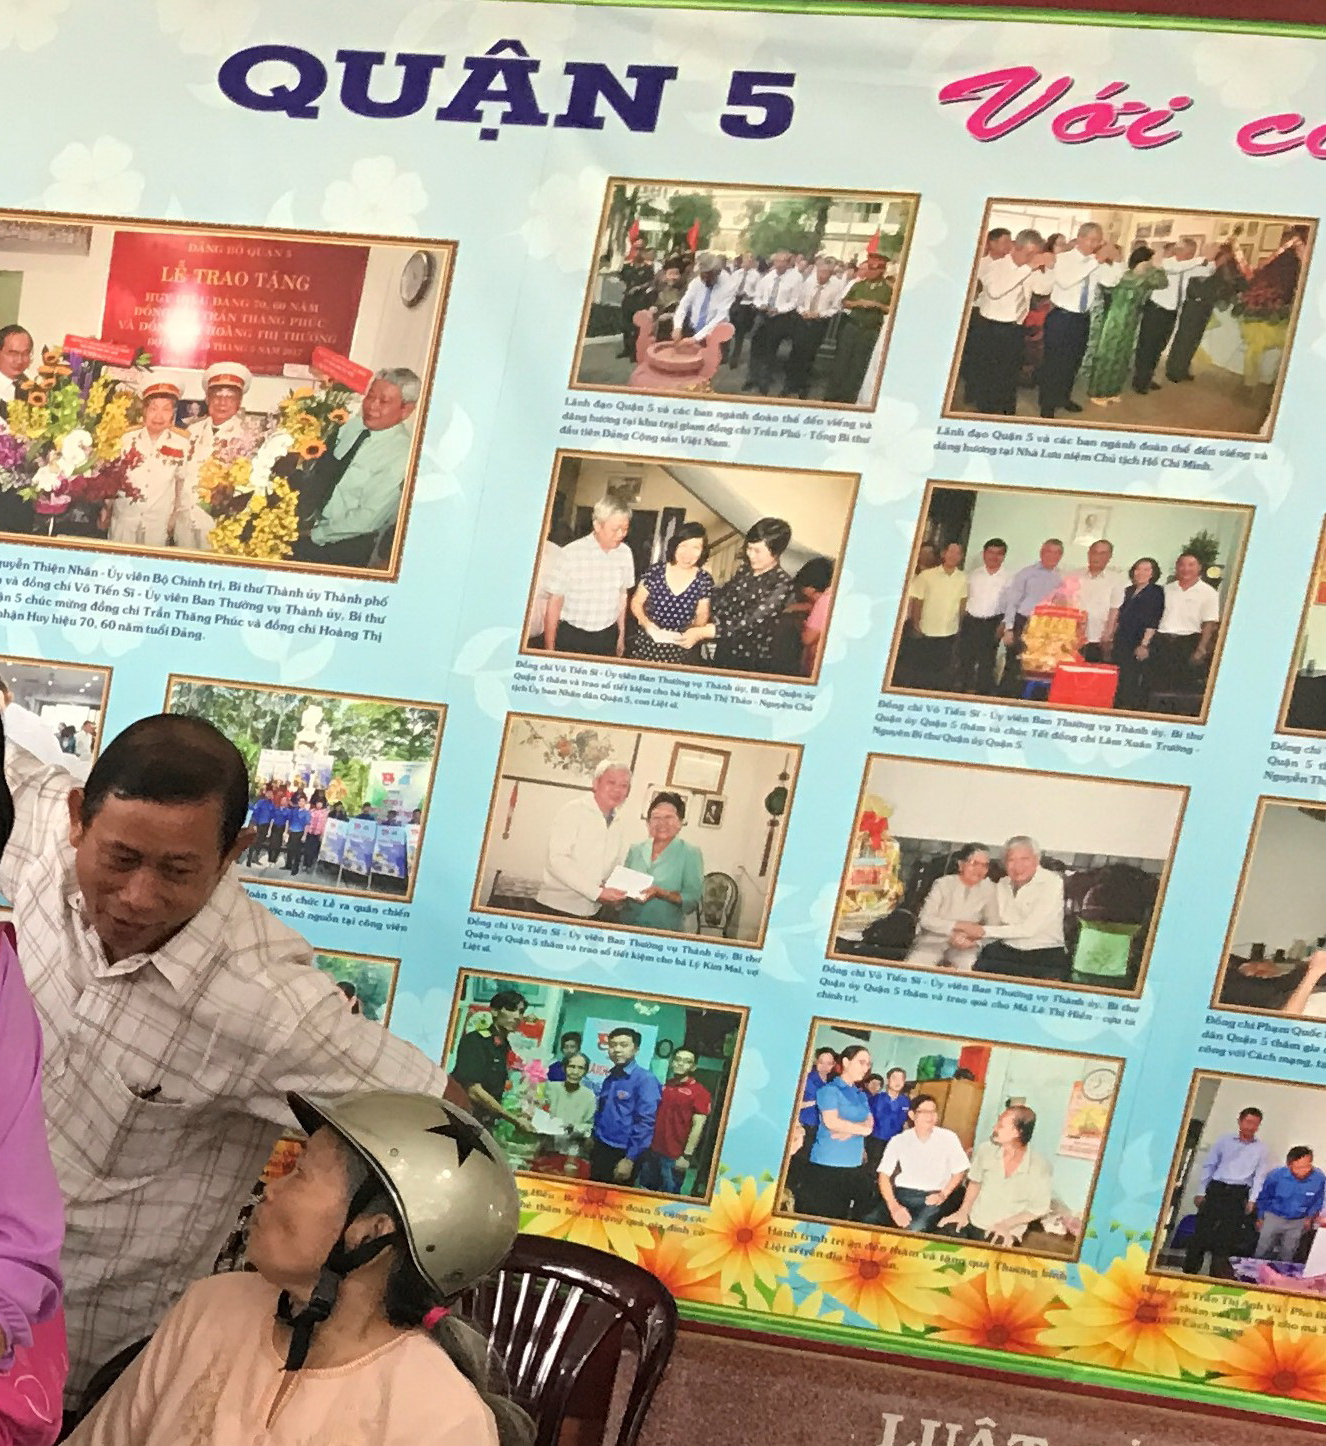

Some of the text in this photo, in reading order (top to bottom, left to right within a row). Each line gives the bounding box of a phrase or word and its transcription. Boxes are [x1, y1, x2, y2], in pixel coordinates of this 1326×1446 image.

[217, 38, 797, 141] QUẬN 5
[938, 66, 1194, 150] Với
[161, 259, 310, 292] LỄ TRAO TẶNG
[6, 576, 18, 586] và
[22, 577, 50, 591] đồng
[54, 581, 71, 592] chí
[75, 583, 90, 593] Võ
[94, 584, 119, 596] Tiến
[123, 587, 135, 597] Sĩ
[164, 592, 189, 603] viên
[192, 595, 215, 606] Ban
[219, 597, 263, 613] Thường
[267, 604, 281, 615] vụ
[286, 604, 323, 618] Thành
[349, 611, 361, 622] Bí
[365, 613, 385, 625] thư
[33, 561, 65, 574] Thiện
[68, 565, 98, 577] Nhân
[126, 570, 150, 582] viên
[153, 574, 168, 586] Bộ
[172, 575, 205, 588] Chính
[229, 581, 240, 591] Bí
[244, 584, 265, 593] thư
[265, 585, 303, 598] Thành
[306, 588, 321, 601] ủy
[324, 591, 362, 604] Thành
[364, 594, 389, 607] phố
[15, 593, 22, 603] 5
[25, 595, 51, 607] chúc
[55, 598, 87, 612] mừng
[90, 600, 119, 616] đồng
[122, 606, 140, 616] chí
[143, 606, 170, 619] Trần
[174, 609, 211, 625] Thăng
[215, 613, 243, 627] Phúc
[248, 619, 260, 628] và
[265, 619, 294, 633] đồng
[298, 623, 316, 634] chí
[319, 625, 358, 641] Hoàng
[362, 629, 382, 643] Thị
[27, 611, 49, 625] Huy
[52, 614, 76, 627] hiệu
[101, 619, 116, 630] 60
[118, 622, 143, 633] năm
[147, 624, 169, 636] tuổi
[171, 626, 206, 641] Đảng.
[271, 892, 278, 900] 5
[281, 892, 292, 902] tổ
[295, 896, 319, 907] chức
[354, 904, 378, 914] quân
[382, 907, 410, 917] chiến
[286, 910, 305, 919] nhớ
[307, 912, 339, 923] nguồn
[342, 917, 355, 926] tại
[358, 919, 383, 930] công
[386, 924, 408, 932] viên
